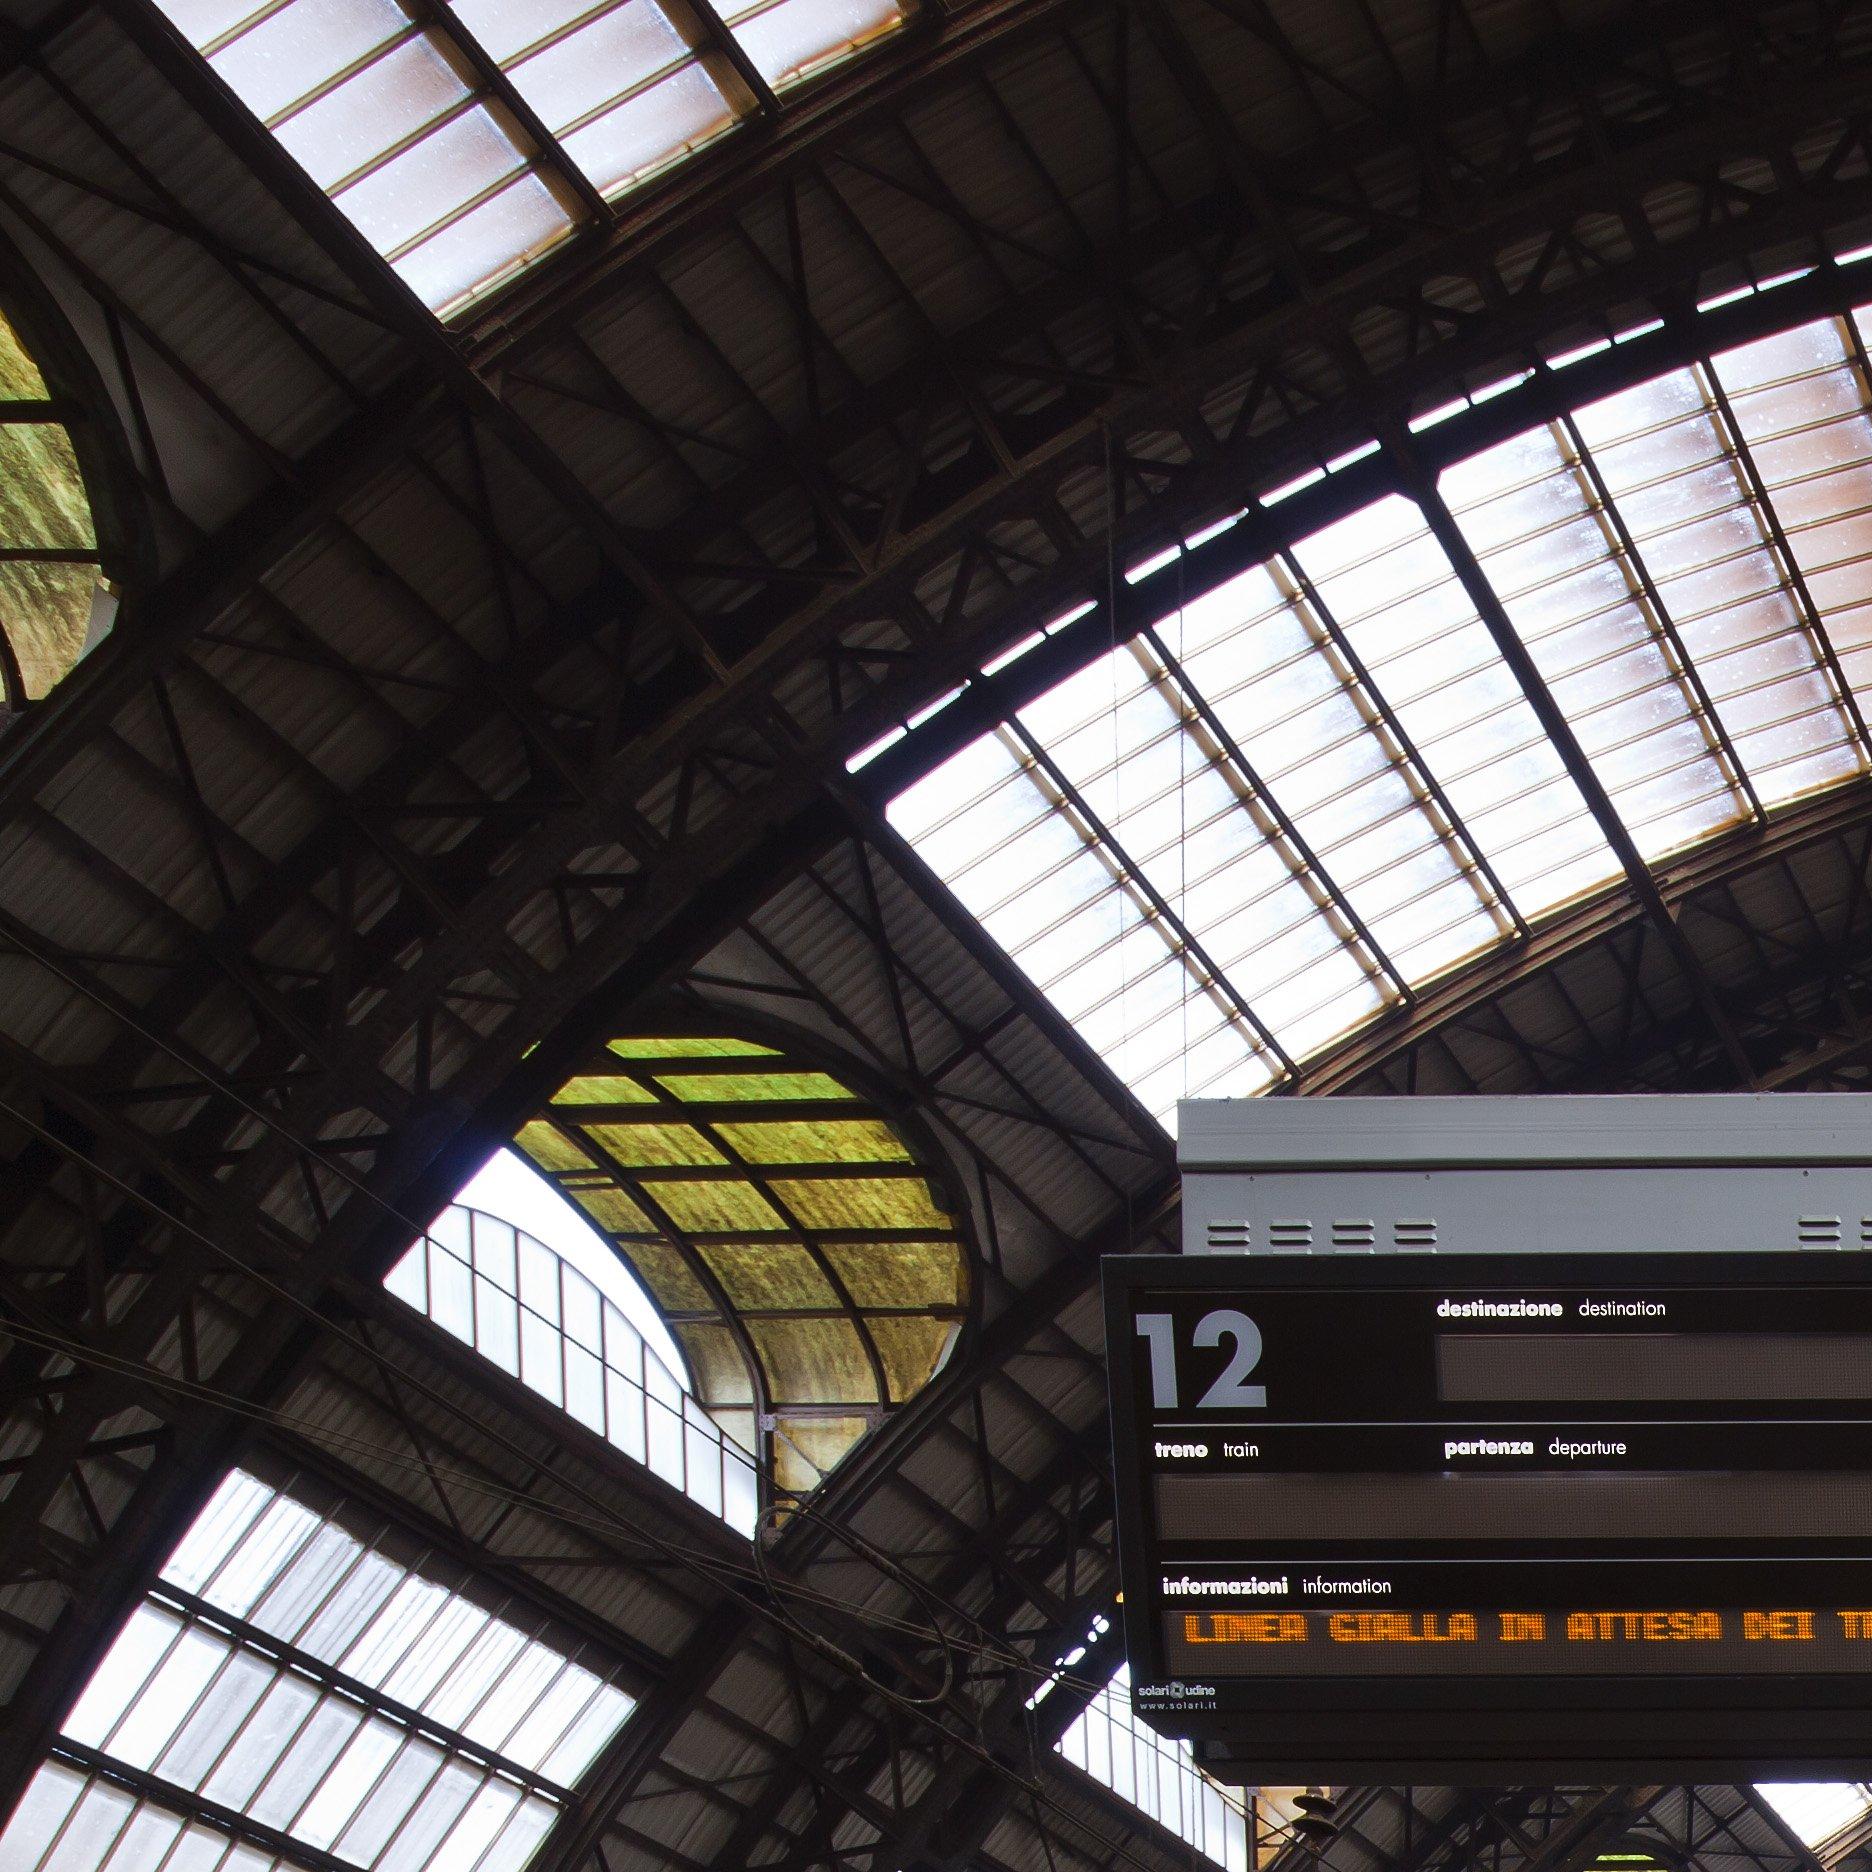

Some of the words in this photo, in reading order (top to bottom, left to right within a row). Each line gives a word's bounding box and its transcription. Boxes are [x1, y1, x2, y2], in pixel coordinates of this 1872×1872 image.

[1436, 1298, 1564, 1318] destinazione
[1578, 1298, 1666, 1317] destination
[1135, 1309, 1267, 1409] 12
[1154, 1442, 1209, 1458] treno
[1223, 1441, 1259, 1458] train
[1444, 1439, 1534, 1460] partenza
[1548, 1436, 1627, 1460] departure
[1162, 1575, 1289, 1595] informazioni
[1302, 1575, 1392, 1594] information
[1184, 1613, 1307, 1644] LINEA
[1328, 1612, 1477, 1644] GIALLA
[1499, 1612, 1545, 1642] IN
[1566, 1611, 1723, 1642] ATTESA
[1743, 1610, 1815, 1641] DEI
[1138, 1684, 1170, 1696] solari
[1185, 1684, 1216, 1696] udine
[1139, 1701, 1217, 1710] www.solari.it
